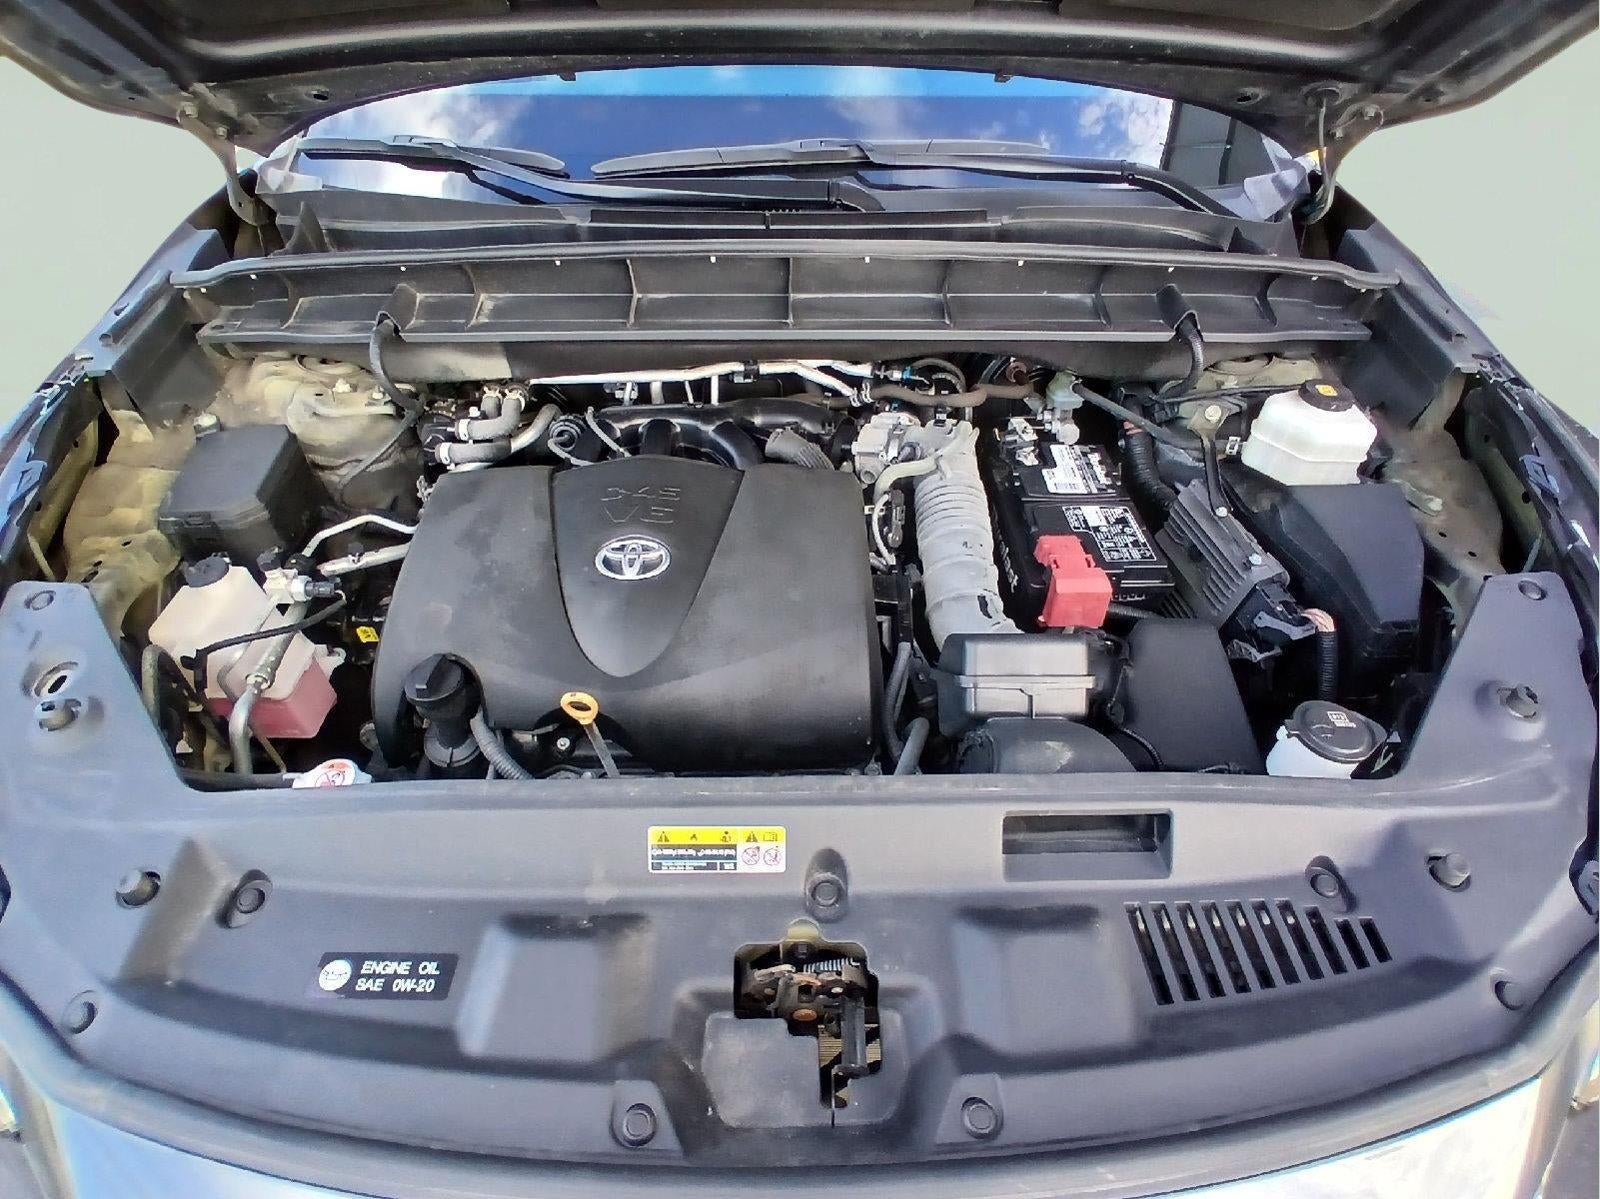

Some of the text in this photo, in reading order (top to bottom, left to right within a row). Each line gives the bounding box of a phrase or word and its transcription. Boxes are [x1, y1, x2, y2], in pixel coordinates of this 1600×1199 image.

[360, 960, 440, 975] ENGINE OIL
[355, 977, 435, 993] SAE 0W-20
